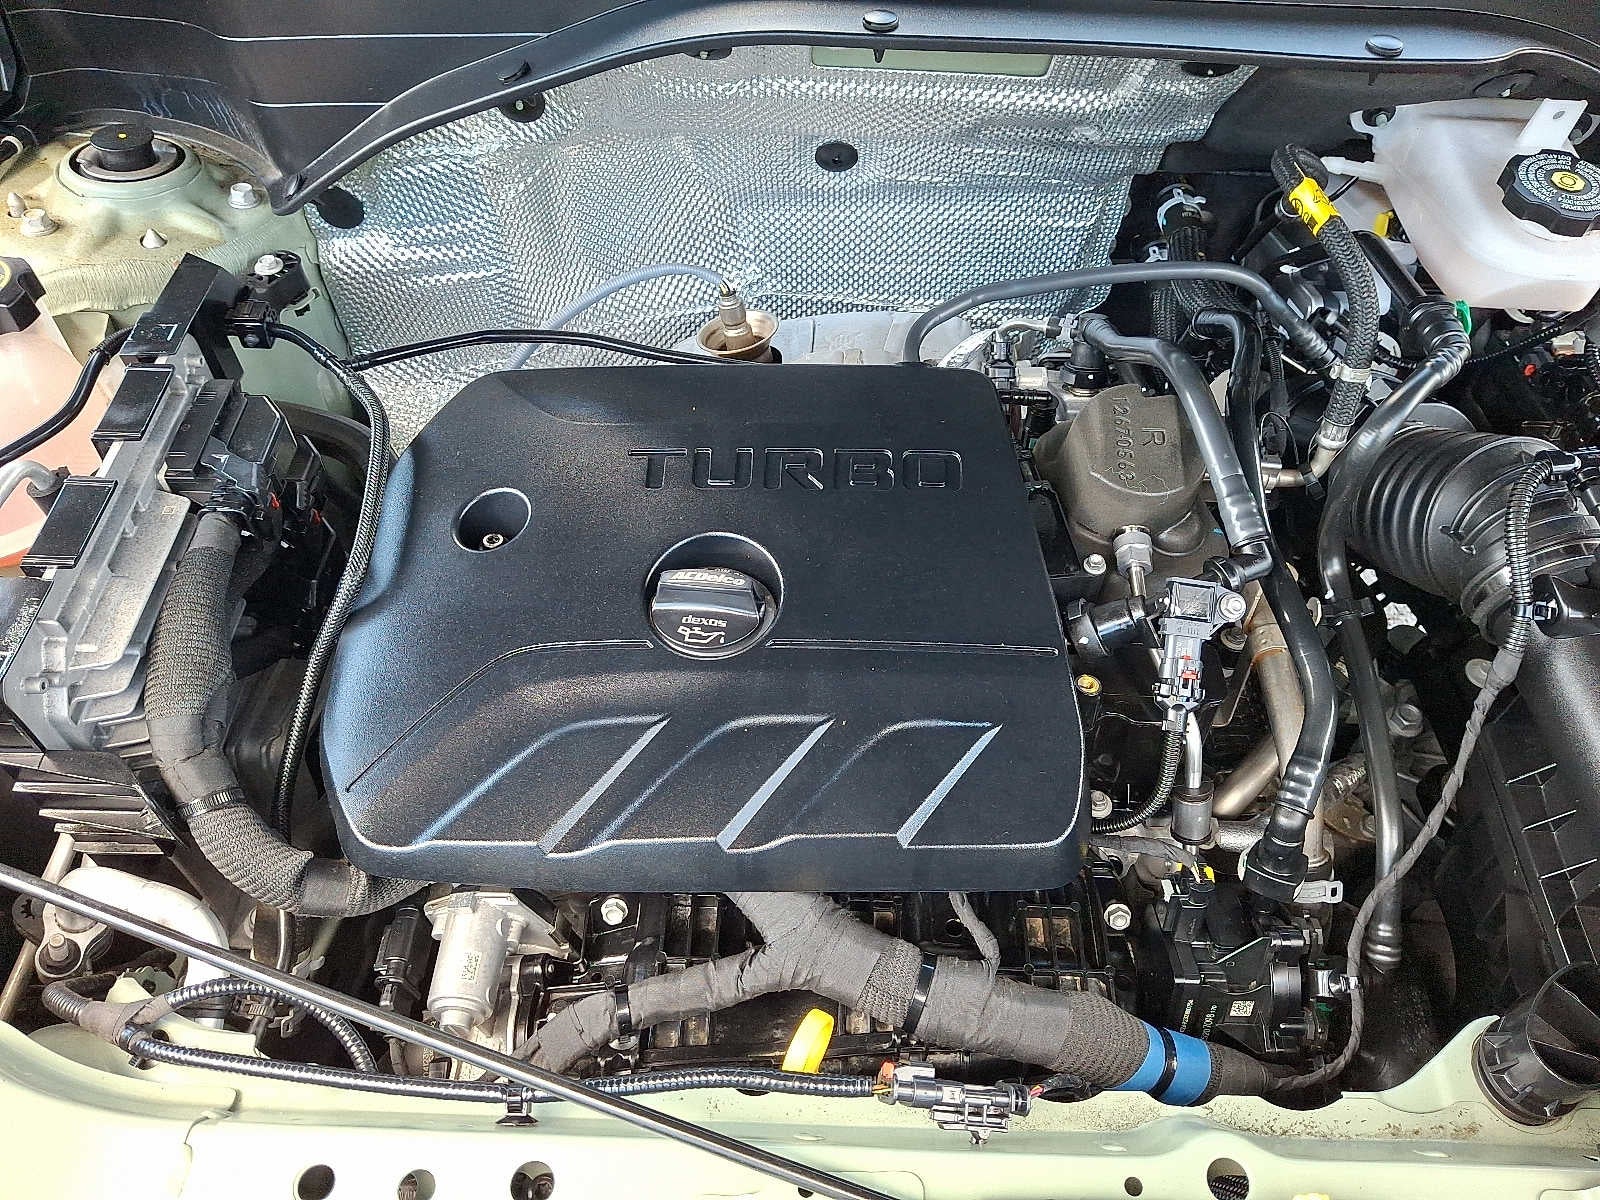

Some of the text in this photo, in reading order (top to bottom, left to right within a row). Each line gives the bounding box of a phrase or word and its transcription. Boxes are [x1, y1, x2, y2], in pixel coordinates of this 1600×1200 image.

[1141, 427, 1166, 446] R
[628, 447, 964, 490] TURBO
[670, 571, 746, 586] ACDelco
[682, 614, 728, 628] dexos
